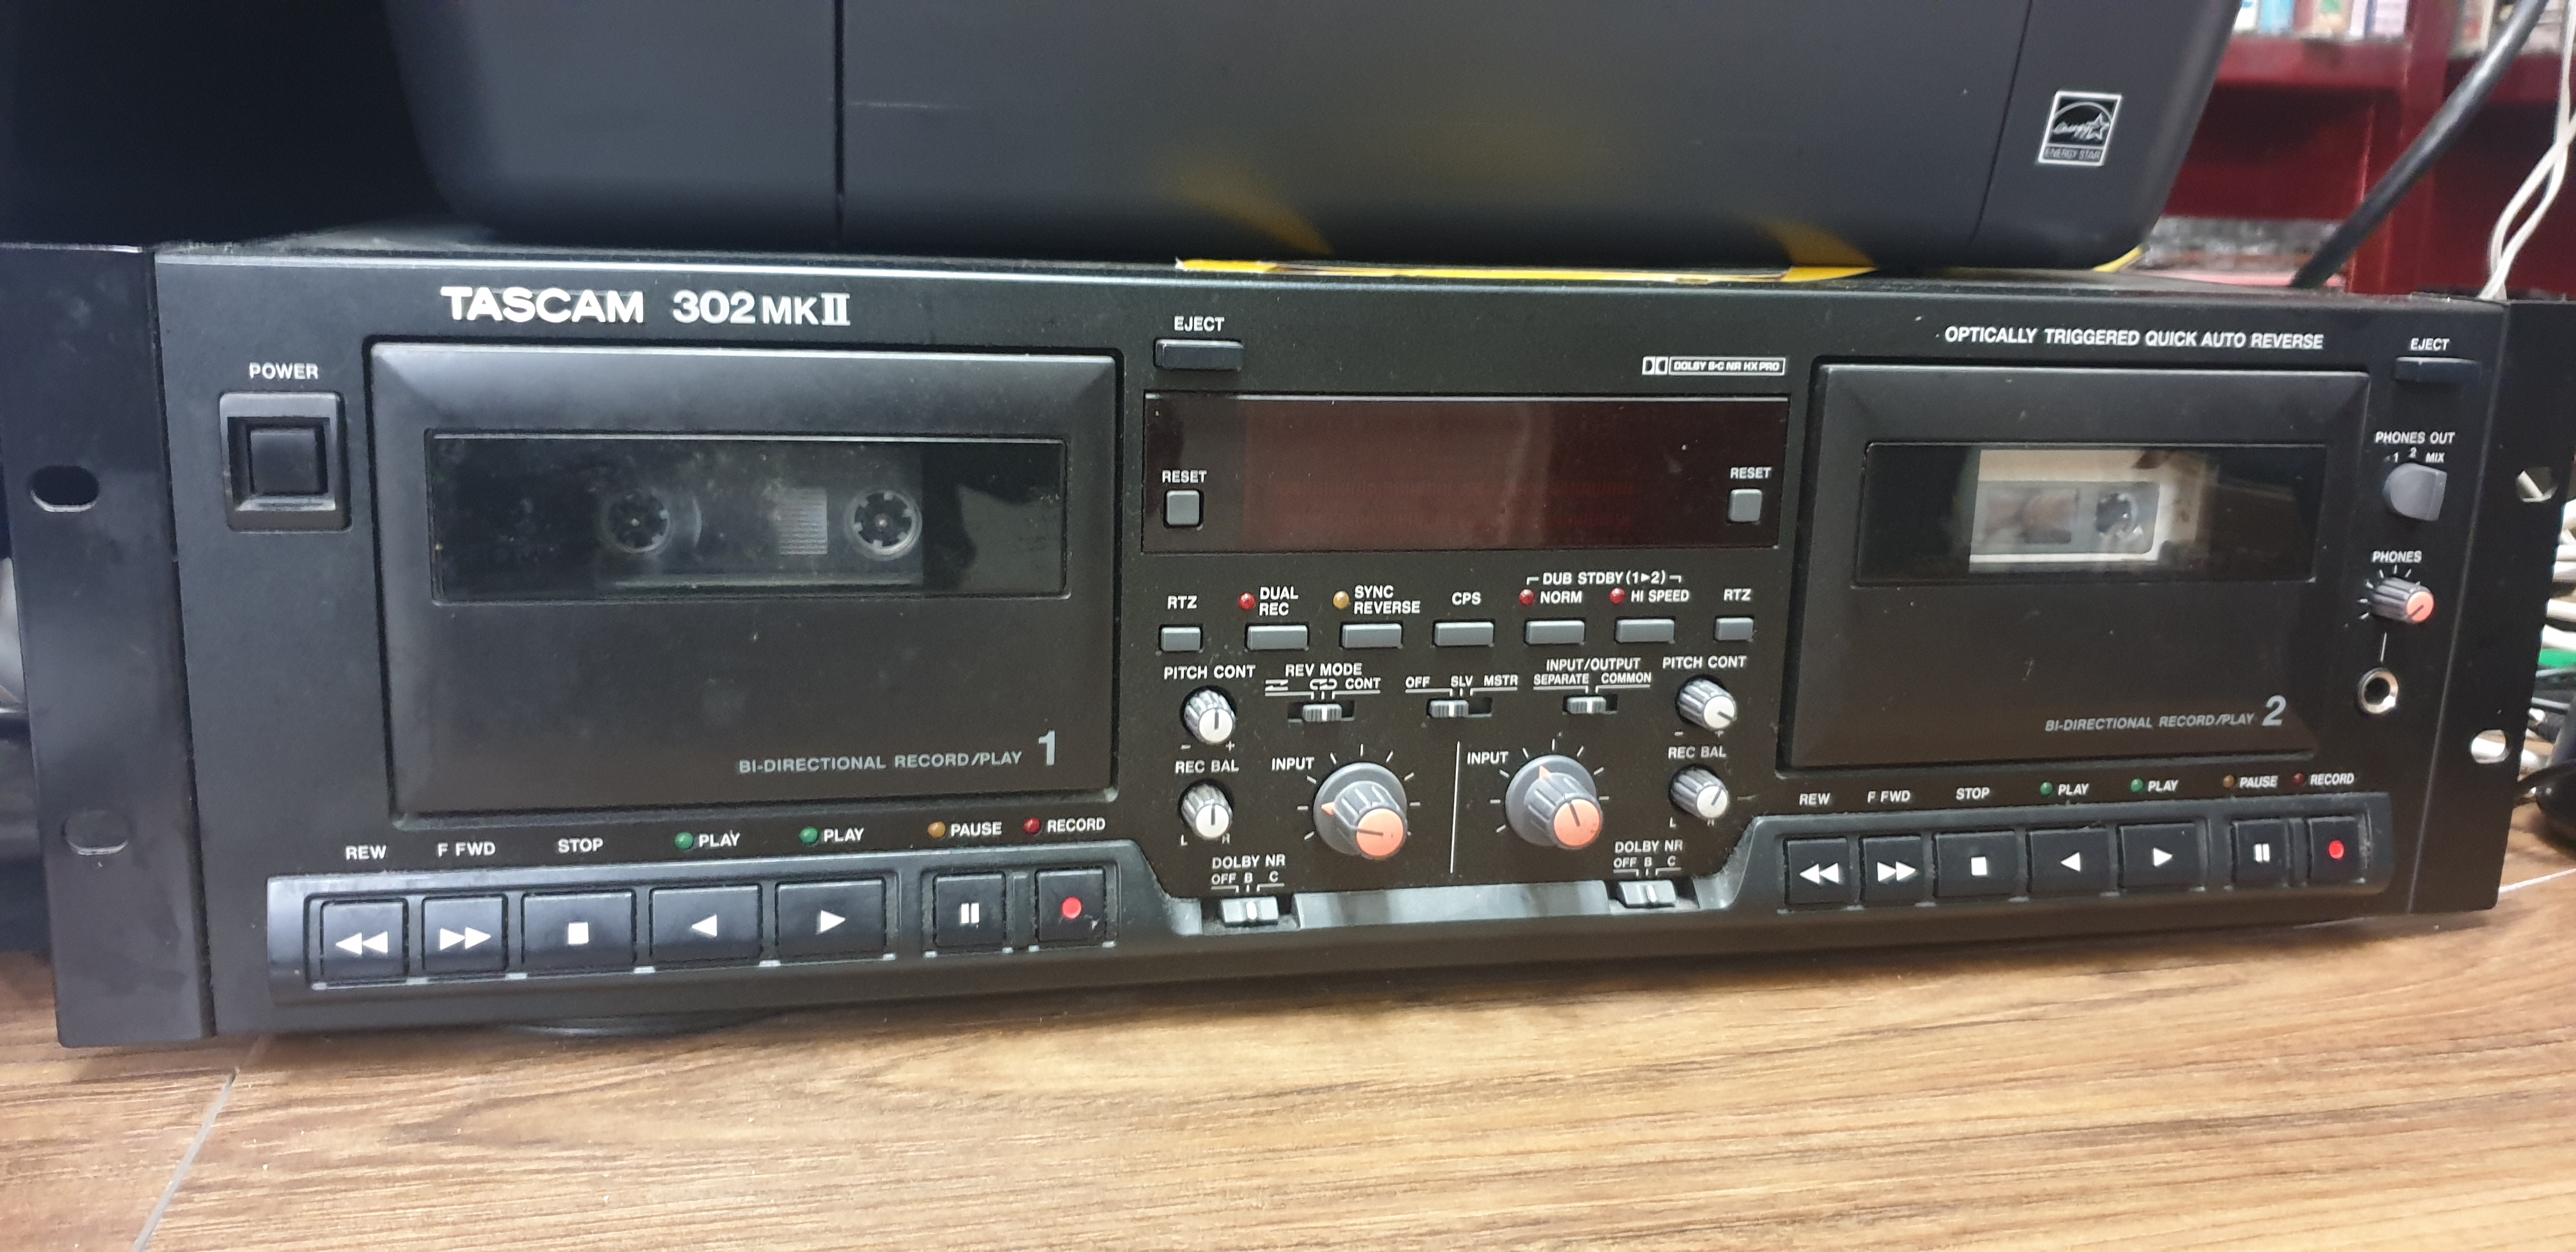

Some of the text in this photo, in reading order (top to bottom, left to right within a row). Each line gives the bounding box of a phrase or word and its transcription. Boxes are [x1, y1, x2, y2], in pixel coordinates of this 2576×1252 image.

[2078, 150, 2101, 160] STAR
[440, 286, 644, 324] TASCAM
[672, 289, 756, 324] 302
[1174, 316, 1225, 332] EJECT
[1944, 326, 2324, 350] OPTICALLY TRIGGERED QUICK AUTO REVERSE
[2410, 337, 2450, 351] EJECT
[249, 362, 319, 380] POWER
[1673, 360, 1706, 372] DOLBY
[1726, 362, 1742, 372] NR
[1743, 362, 1758, 372] HX
[1758, 362, 1780, 372] PRO
[2375, 431, 2456, 445] PHONES OUT
[2393, 447, 2445, 463] 1 2 MIX
[1162, 470, 1208, 484] RESET
[1730, 466, 1772, 480] RESET
[2372, 550, 2422, 563] PHONES
[1541, 570, 1574, 587] DUB
[1259, 586, 1299, 600] DUAL
[1354, 584, 1394, 599] SYNC
[1452, 592, 1482, 606] CPS
[1540, 590, 1583, 604] NORM
[1630, 589, 1690, 603] HI SPEED
[1723, 588, 1752, 601] RTZ
[1167, 595, 1197, 609] RTZ
[1259, 602, 1289, 616] REC
[1354, 600, 1421, 615] REVERSE
[1546, 657, 1641, 672] INPUT/OUTPUT
[1662, 655, 1747, 669] PITCH CONT
[1163, 664, 1256, 680] PITCH CONT
[1285, 662, 1363, 678] REV MODE
[1345, 677, 1381, 690] CONT
[1405, 674, 1519, 689] OFF SLV MSTR
[1533, 671, 1652, 687] SEPARATE COMMON
[2262, 695, 2287, 726] 2
[2044, 713, 2255, 732] BI-DIRECTIONAL RECORD/PLAY
[1038, 730, 1055, 766] 1
[1667, 745, 1727, 760] REC BAL
[739, 751, 1022, 774] BI-DIRECTIONAL RECORD/PLAY
[1271, 756, 1315, 771] INPUT
[1467, 751, 1509, 765] INPUT
[1175, 759, 1239, 774] REC BAL
[2147, 779, 2179, 792] PLAY
[2239, 775, 2278, 789] PAUSE
[2310, 772, 2355, 786] RECORD
[1867, 790, 1911, 803] F FWD
[1956, 787, 1990, 800] STOP
[2057, 782, 2089, 797] PLAY
[1799, 792, 1830, 806] REW
[951, 821, 1002, 837] PAUSE
[1046, 817, 1106, 833] RECORD
[1669, 816, 1677, 828] L
[698, 832, 740, 848] PLAY
[823, 827, 864, 843] PLAY
[1180, 834, 1188, 846] L
[345, 844, 387, 860] REW
[438, 841, 496, 857] F FWD
[557, 837, 604, 853] STOP
[1614, 839, 1683, 853] DOLBY NR
[1212, 853, 1285, 869] DOLBY NR
[1613, 855, 1676, 869] OFF B C
[1211, 870, 1278, 885] OFF B C
